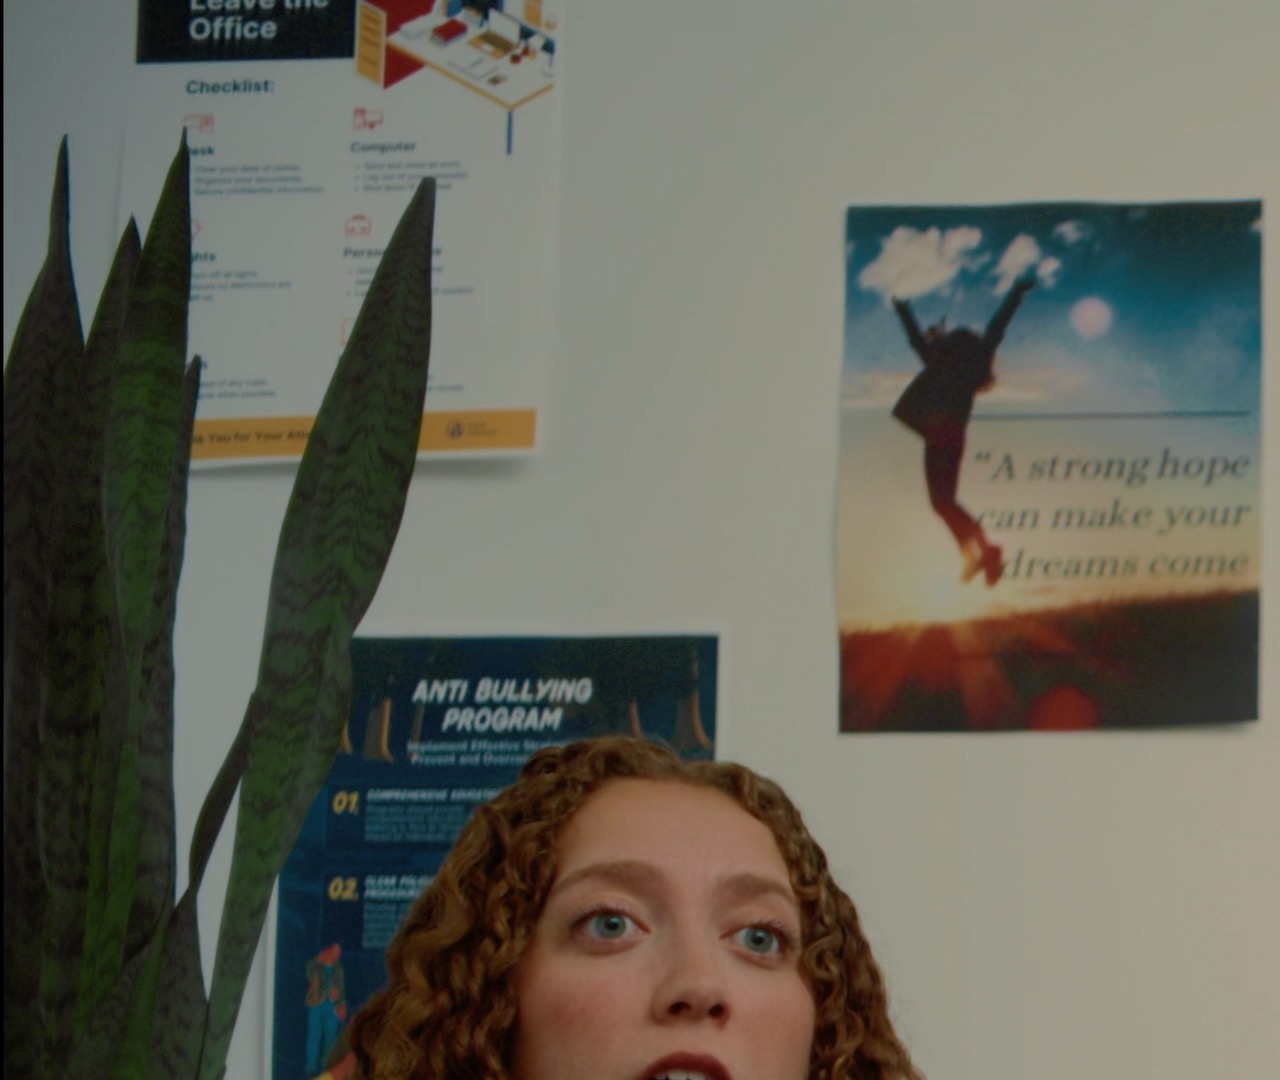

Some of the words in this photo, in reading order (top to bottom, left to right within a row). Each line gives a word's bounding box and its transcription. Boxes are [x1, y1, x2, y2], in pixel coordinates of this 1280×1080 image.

[189, 16, 277, 40] Office
[185, 79, 275, 95] Checklist:
[350, 140, 417, 155] Computer
[1028, 452, 1150, 487] strong
[1157, 447, 1252, 487] hope
[976, 507, 1040, 531] can
[1051, 497, 1153, 529] make
[1157, 504, 1253, 537] your
[1002, 549, 1139, 579] dreams
[1147, 553, 1251, 578] come
[412, 679, 467, 703] ANTI
[474, 677, 593, 704] BULLYING
[441, 708, 564, 733] PROGRAM
